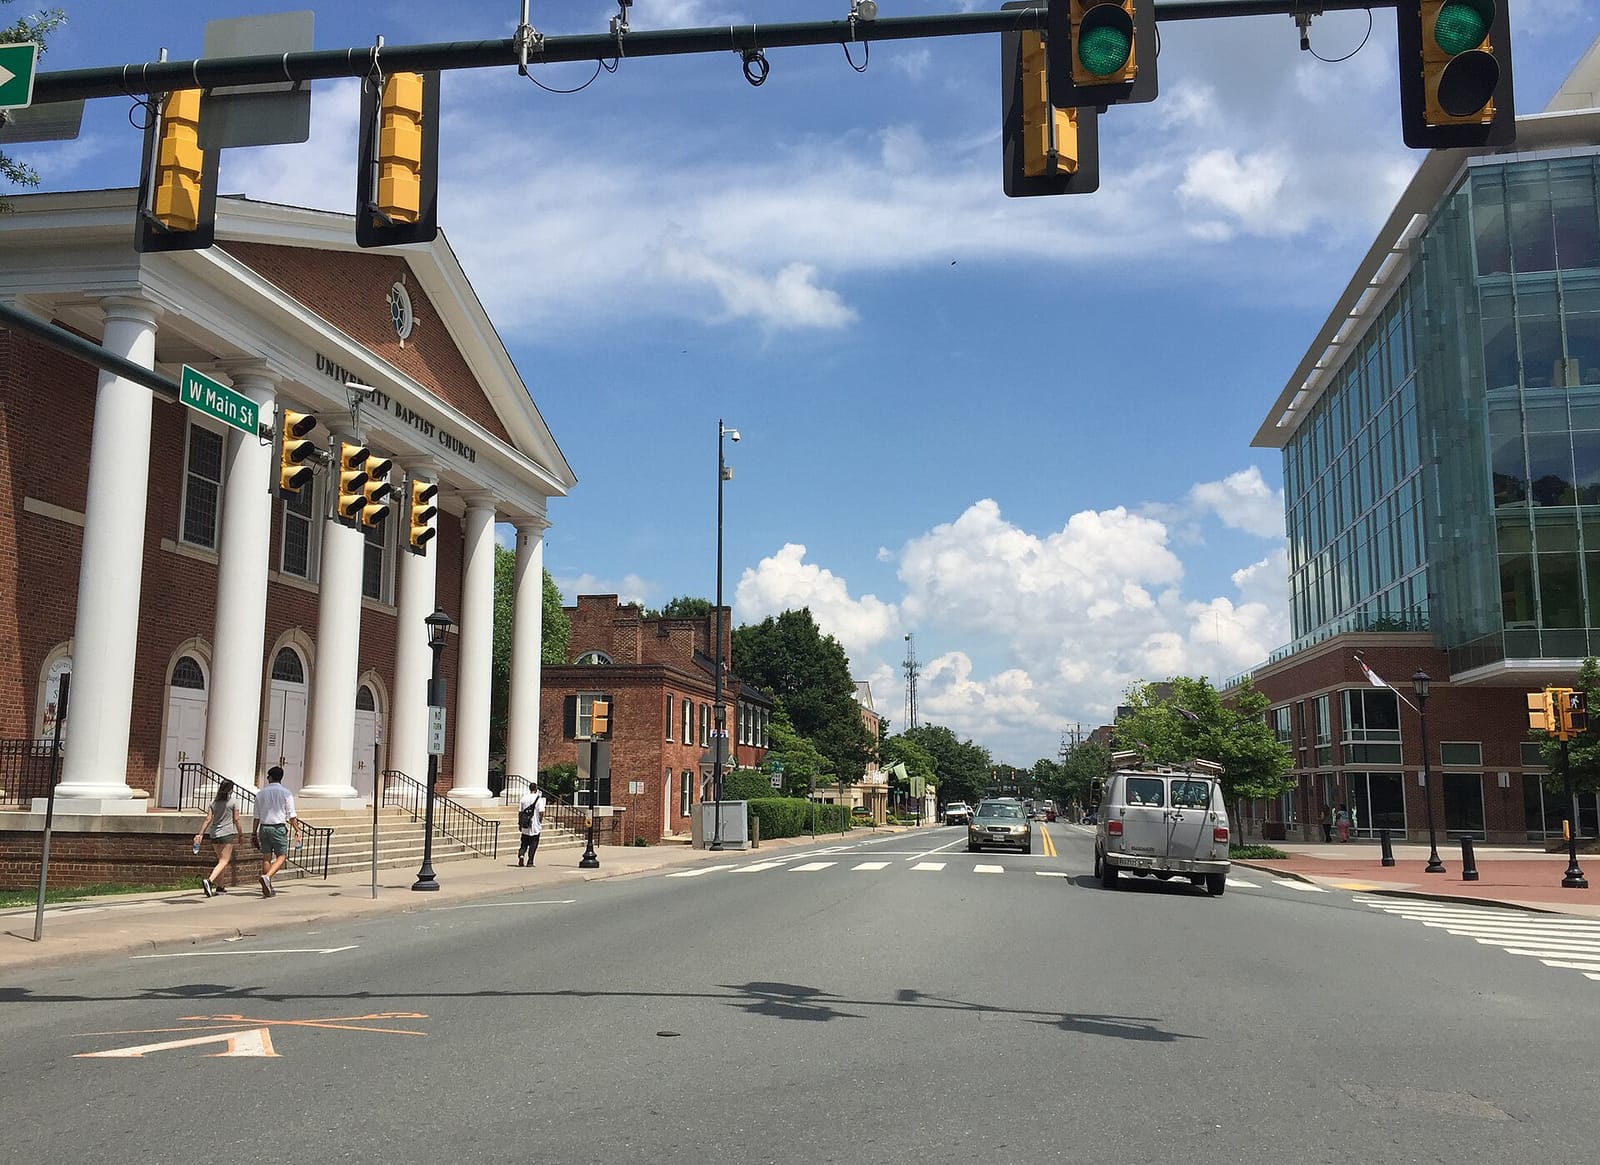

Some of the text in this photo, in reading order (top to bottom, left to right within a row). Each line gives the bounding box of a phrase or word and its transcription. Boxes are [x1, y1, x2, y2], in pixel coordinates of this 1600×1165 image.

[190, 379, 254, 428] W Main St
[395, 401, 435, 438] BAPTIST
[438, 430, 476, 463] CHURCH
